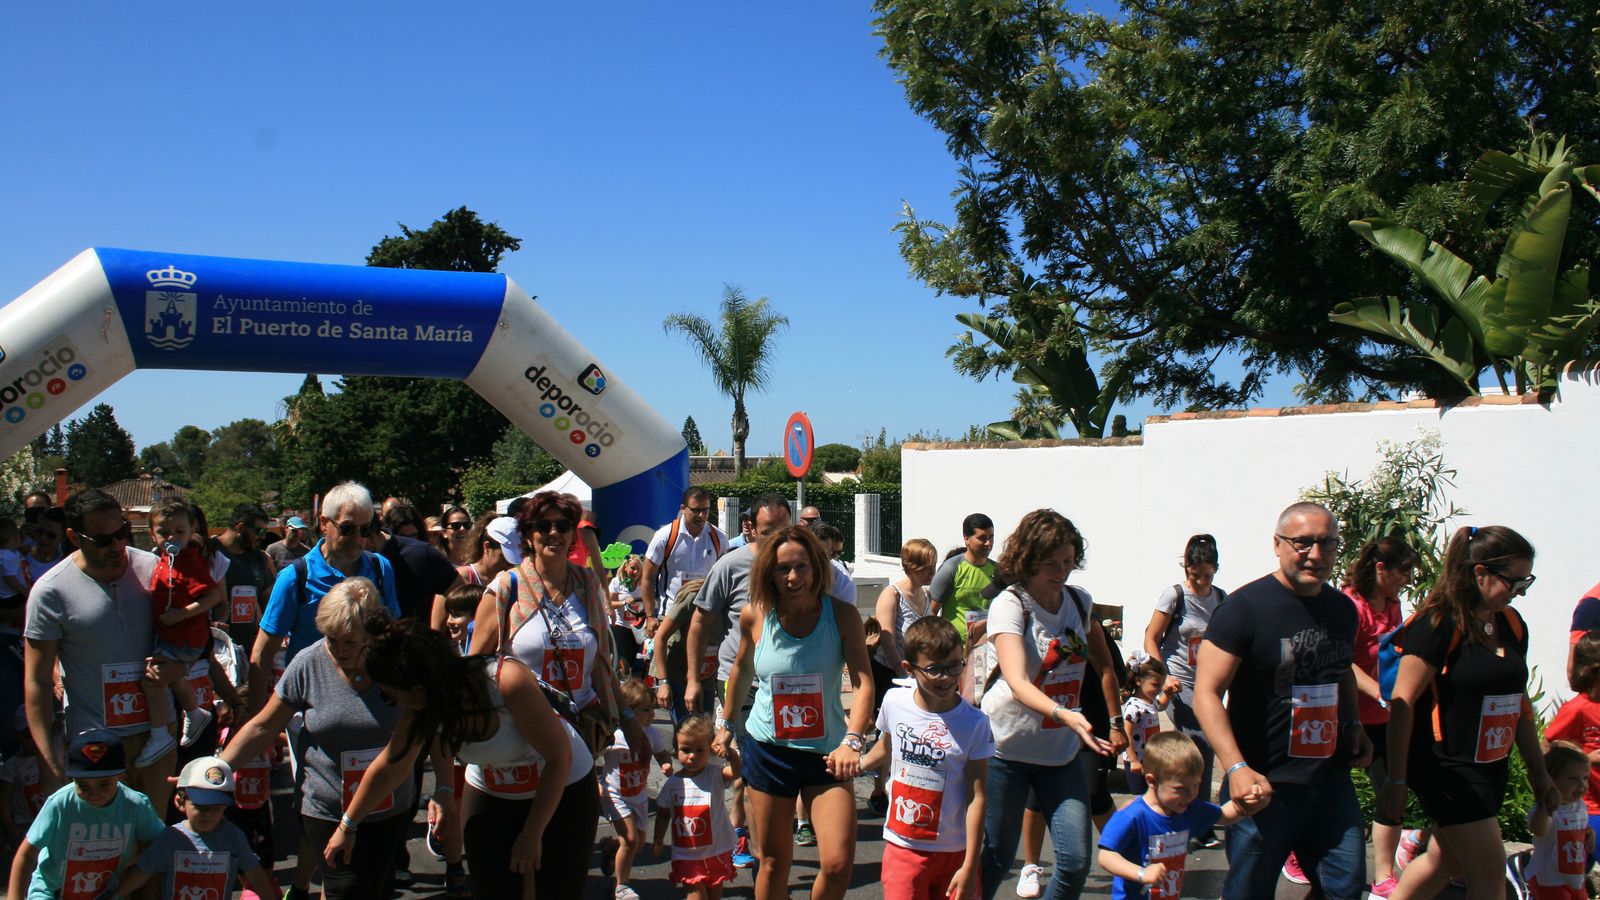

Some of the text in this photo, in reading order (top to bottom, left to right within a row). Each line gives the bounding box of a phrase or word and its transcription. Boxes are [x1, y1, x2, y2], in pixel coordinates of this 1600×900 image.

[213, 294, 374, 316] Ayuntamiento de
[211, 316, 474, 343] El Puerto de Santa María
[0, 347, 76, 412] orocio
[524, 363, 615, 448] deporocio
[779, 705, 819, 729] 100
[895, 796, 935, 828] 100
